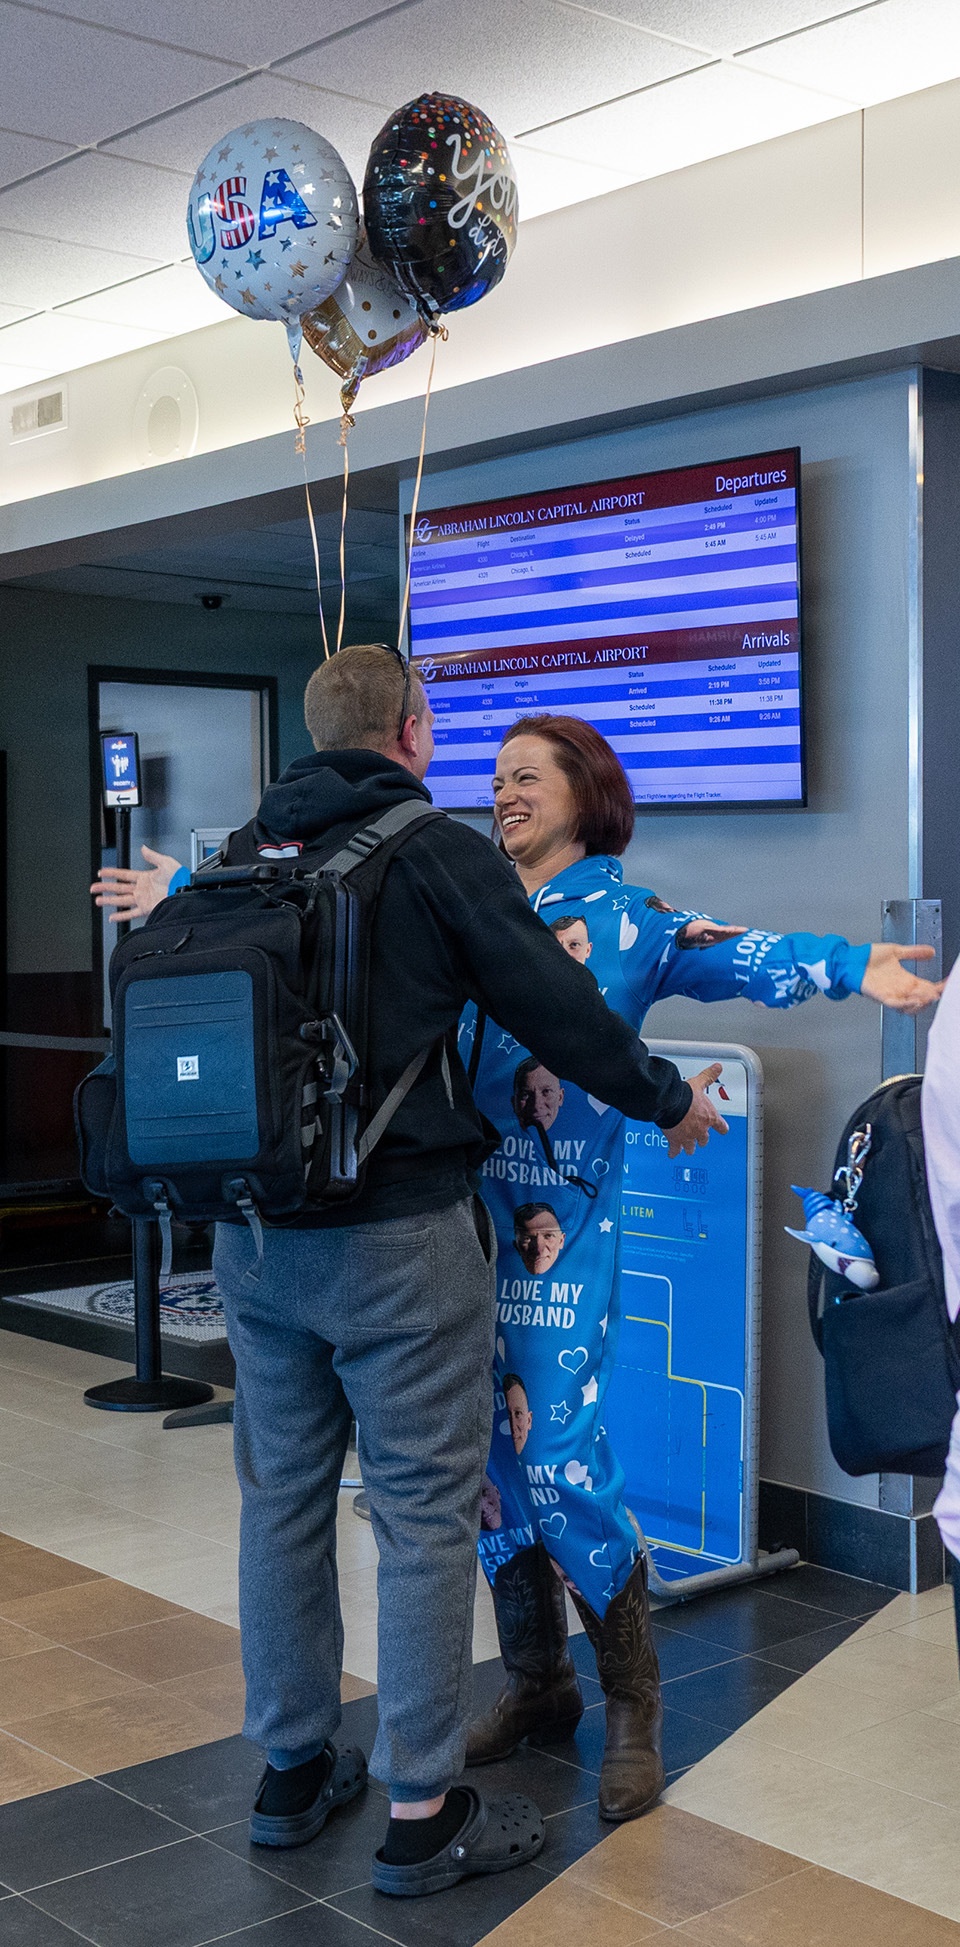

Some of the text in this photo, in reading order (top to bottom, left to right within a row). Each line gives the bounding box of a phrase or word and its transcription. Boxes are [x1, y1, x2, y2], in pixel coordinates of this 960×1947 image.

[445, 133, 519, 230] You
[187, 168, 318, 264] USA
[468, 214, 503, 257] did
[716, 469, 787, 493] Departures
[437, 491, 646, 537] ABRAHAM LINCOLN CAPITAL AIRPORT
[477, 540, 490, 549] Flight
[510, 534, 536, 543] Destination
[624, 518, 640, 526] Status
[704, 503, 732, 514] Scheduled
[754, 497, 778, 507] Updated
[624, 533, 645, 543] Delayed
[716, 521, 726, 530] PM
[755, 515, 766, 524] 4:00
[767, 514, 777, 522] PM
[625, 549, 651, 560] Scheduled
[705, 540, 715, 548] 5:45
[715, 538, 726, 547] AM
[755, 534, 766, 542] 5:45
[765, 532, 777, 540] AM
[742, 629, 790, 649] Arrivals
[441, 645, 649, 677] ABRAHAM LINCOLN CAPITAL AIRPORT
[481, 659, 781, 691] Flight Origin Status Scheduled Updated
[628, 687, 647, 695] Arrived
[720, 680, 730, 688] PM
[770, 676, 780, 685] PM
[629, 703, 655, 711] Scheduled
[774, 694, 783, 702] PM
[629, 720, 656, 728] Scheduled
[721, 715, 731, 723] AM
[770, 712, 781, 720] AM
[694, 791, 705, 799] Flight
[553, 1140, 586, 1161] MY
[644, 1129, 669, 1148] che
[482, 1158, 578, 1186] HUSBAND
[630, 1206, 654, 1219] ITEM
[500, 1279, 584, 1305] LOVE MY
[526, 1464, 557, 1485] MY
[509, 1523, 535, 1546] MY
